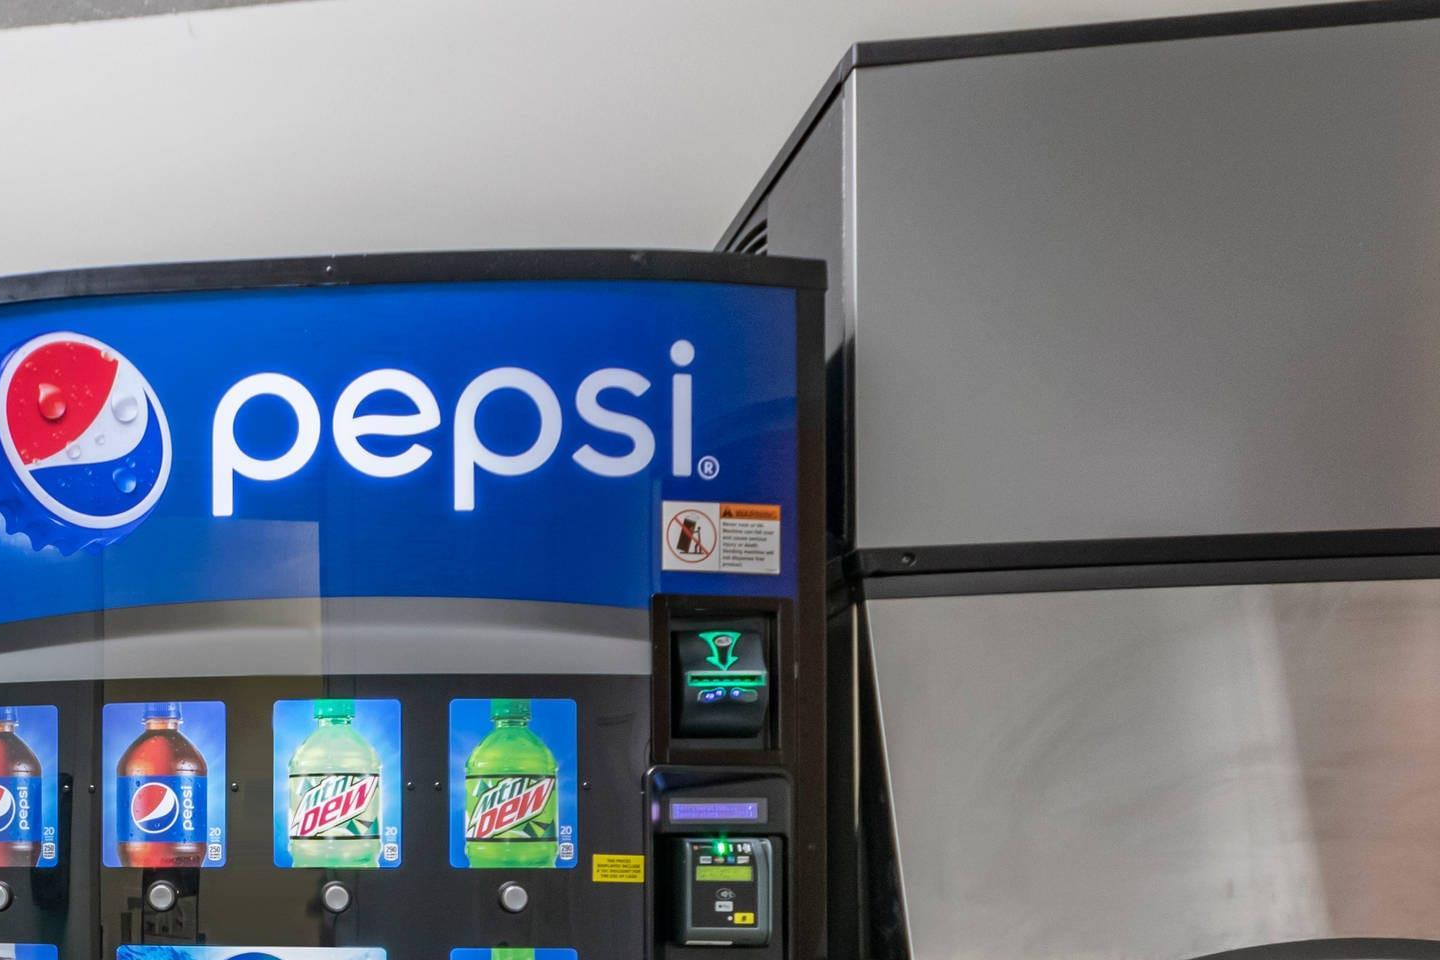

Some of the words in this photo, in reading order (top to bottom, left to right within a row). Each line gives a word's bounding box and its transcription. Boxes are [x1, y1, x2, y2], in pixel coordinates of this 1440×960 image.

[211, 339, 693, 517] pepsi
[19, 786, 31, 831] pepsi
[181, 785, 195, 832] pepsi
[43, 826, 55, 836] 20
[209, 826, 222, 837] 20
[384, 826, 398, 836] 20
[560, 825, 572, 835] 20
